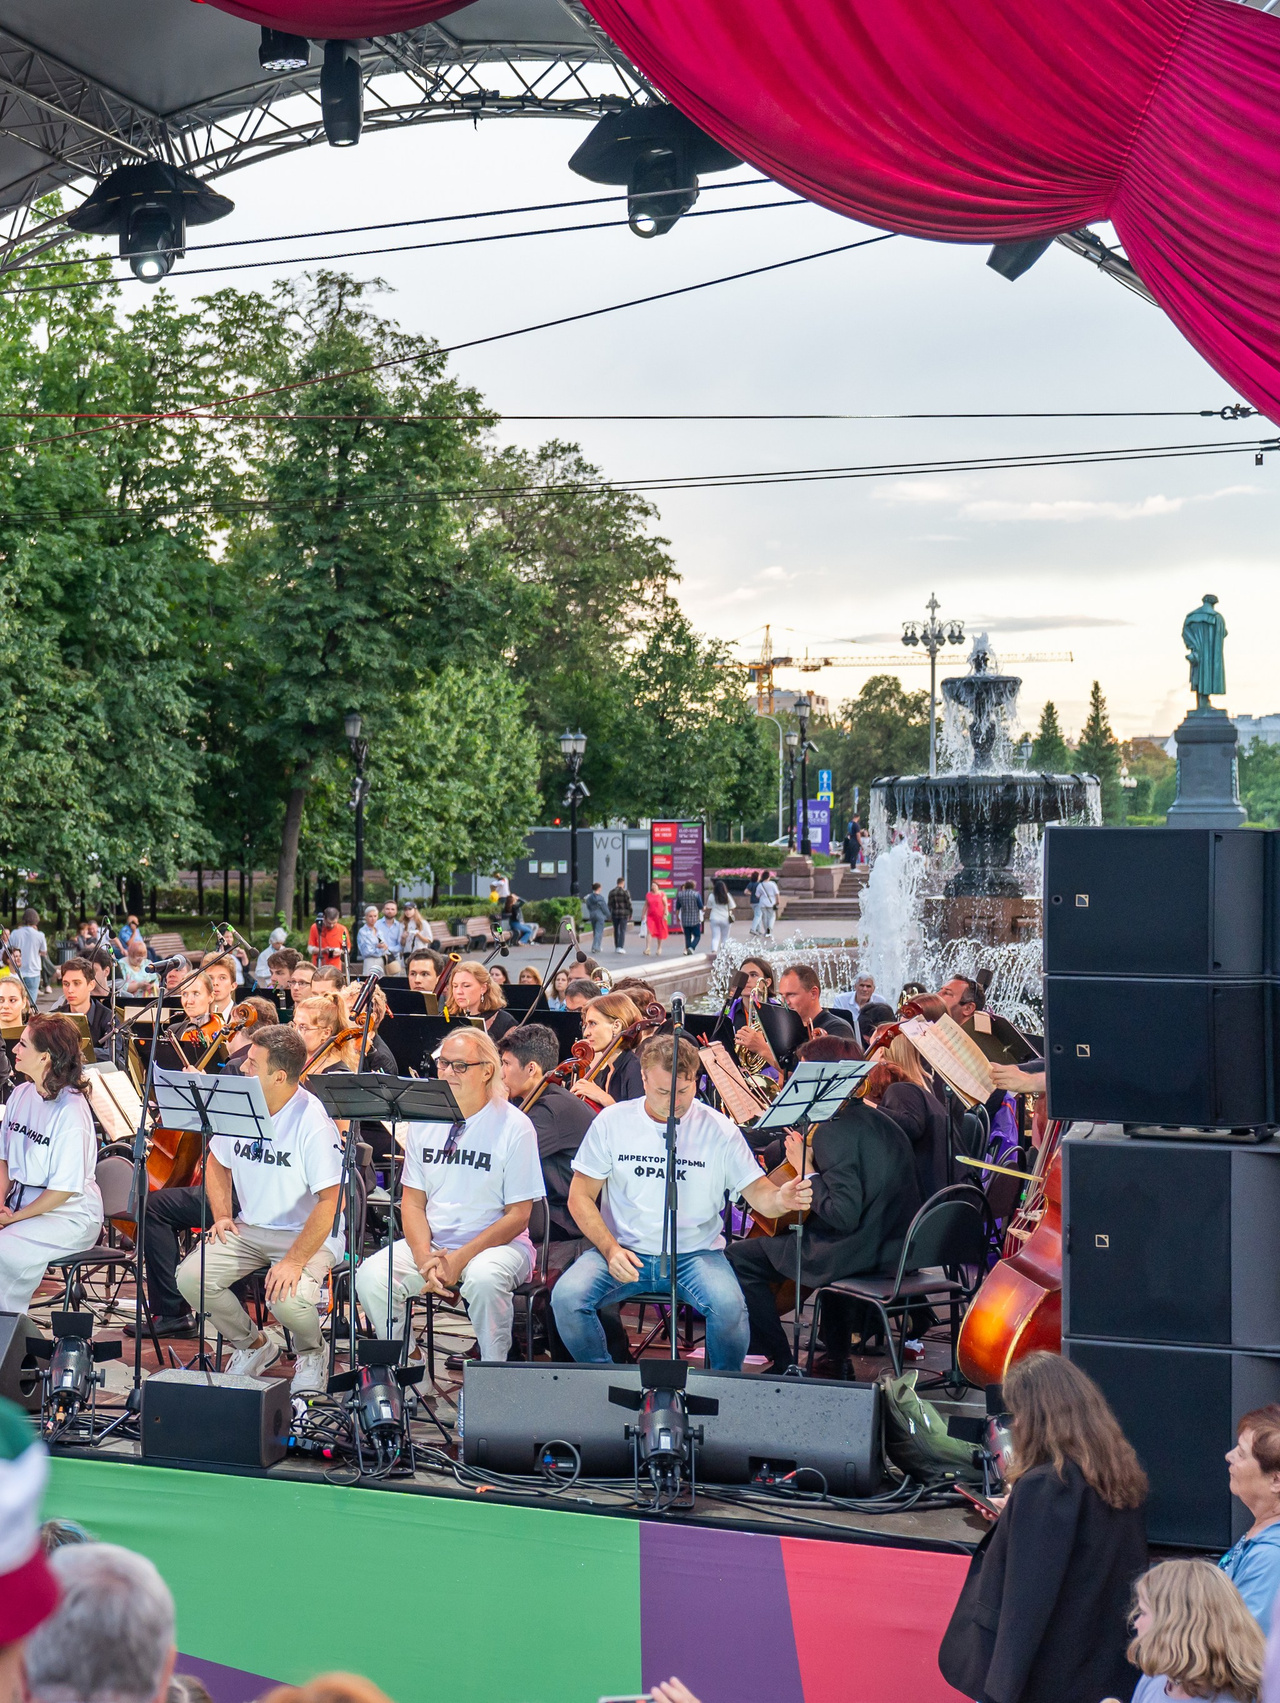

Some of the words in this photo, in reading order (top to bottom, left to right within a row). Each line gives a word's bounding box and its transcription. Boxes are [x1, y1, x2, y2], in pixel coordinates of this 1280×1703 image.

[594, 836, 622, 850] WC
[422, 1147, 492, 1172] БЛИНД
[617, 1154, 666, 1164] ДИРЕКТОР
[634, 1165, 687, 1181] ФРАК
